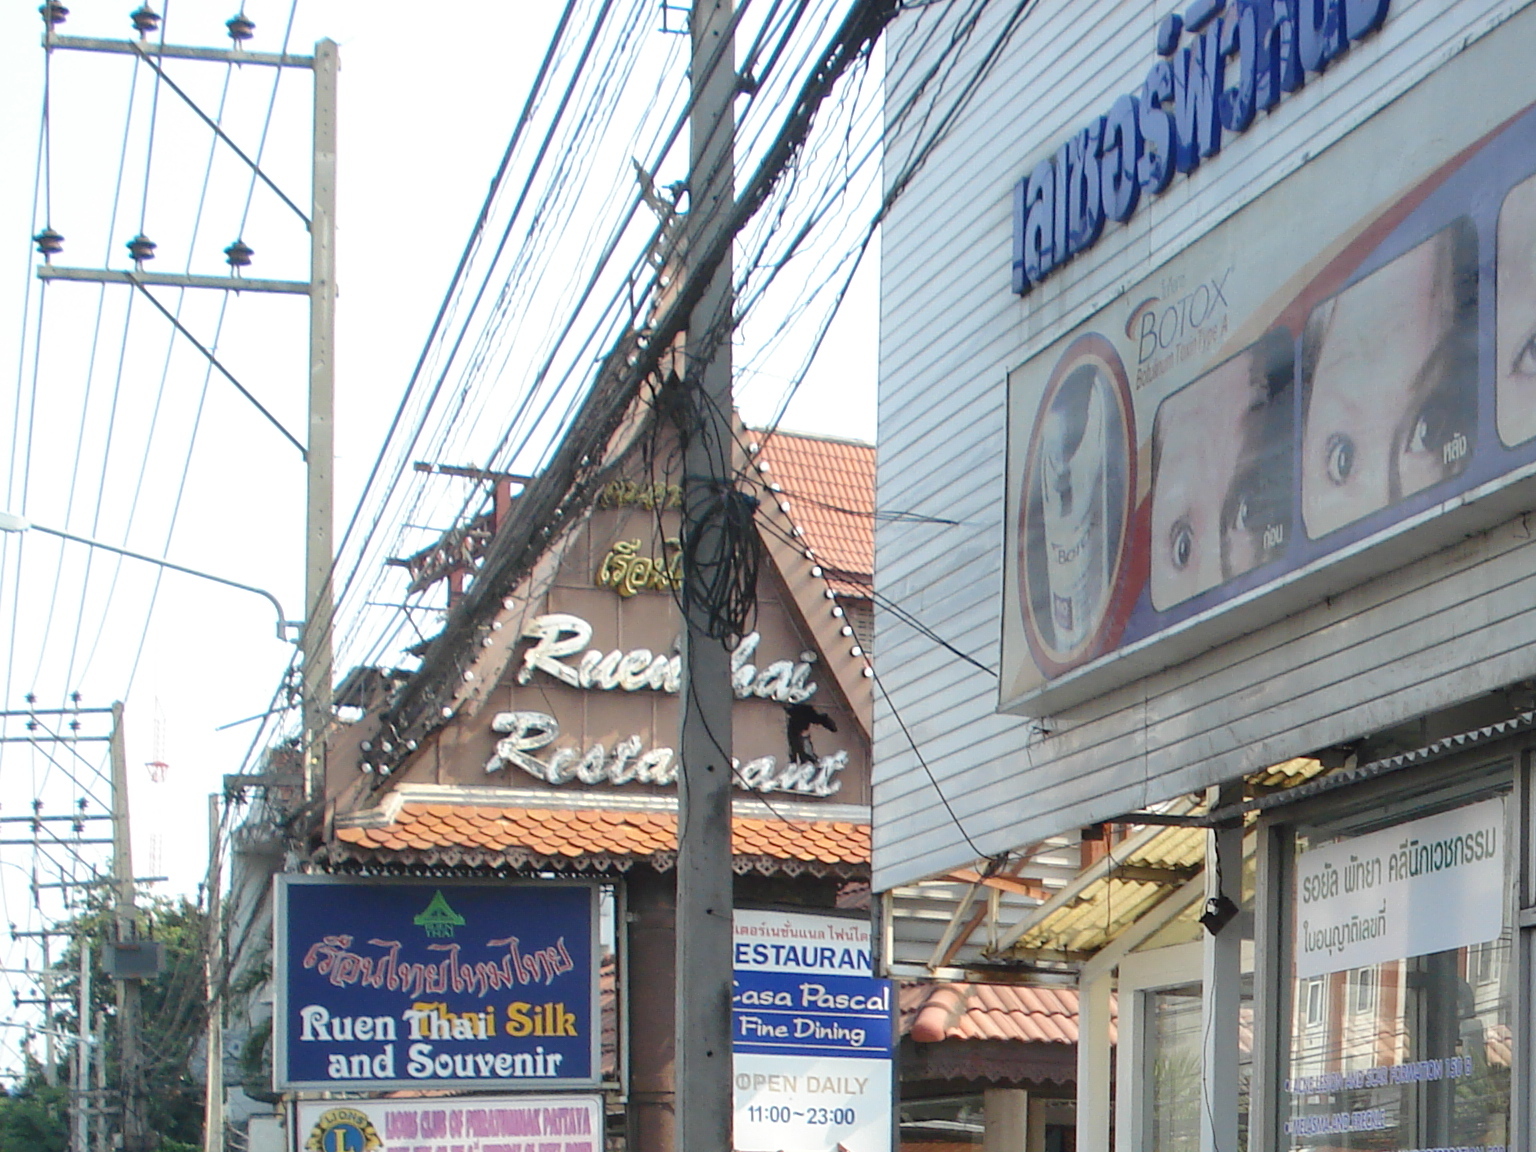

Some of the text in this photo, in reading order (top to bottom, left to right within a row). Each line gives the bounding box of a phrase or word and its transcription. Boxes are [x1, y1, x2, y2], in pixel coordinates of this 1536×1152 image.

[1138, 267, 1232, 364] BOTOX
[516, 612, 819, 704] Ruen hai
[484, 709, 851, 799] Restaant
[1303, 862, 1338, 904] รอยัล
[1344, 854, 1382, 894] พัทยา
[302, 934, 574, 999] เรือนไทยไหมไทย
[734, 942, 872, 971] ESTAURAN
[799, 983, 890, 1011] Pascal
[300, 1004, 398, 1041] Ruen
[505, 1001, 578, 1037] Silk
[738, 1015, 867, 1047] Fine Dining
[328, 1043, 564, 1079] and Souvenir
[735, 1073, 870, 1095] OPEN DAILY
[325, 1111, 365, 1124] LIONS
[421, 1110, 447, 1138] CLUB
[449, 1110, 463, 1138] OF
[543, 1107, 591, 1136] PATTAYA
